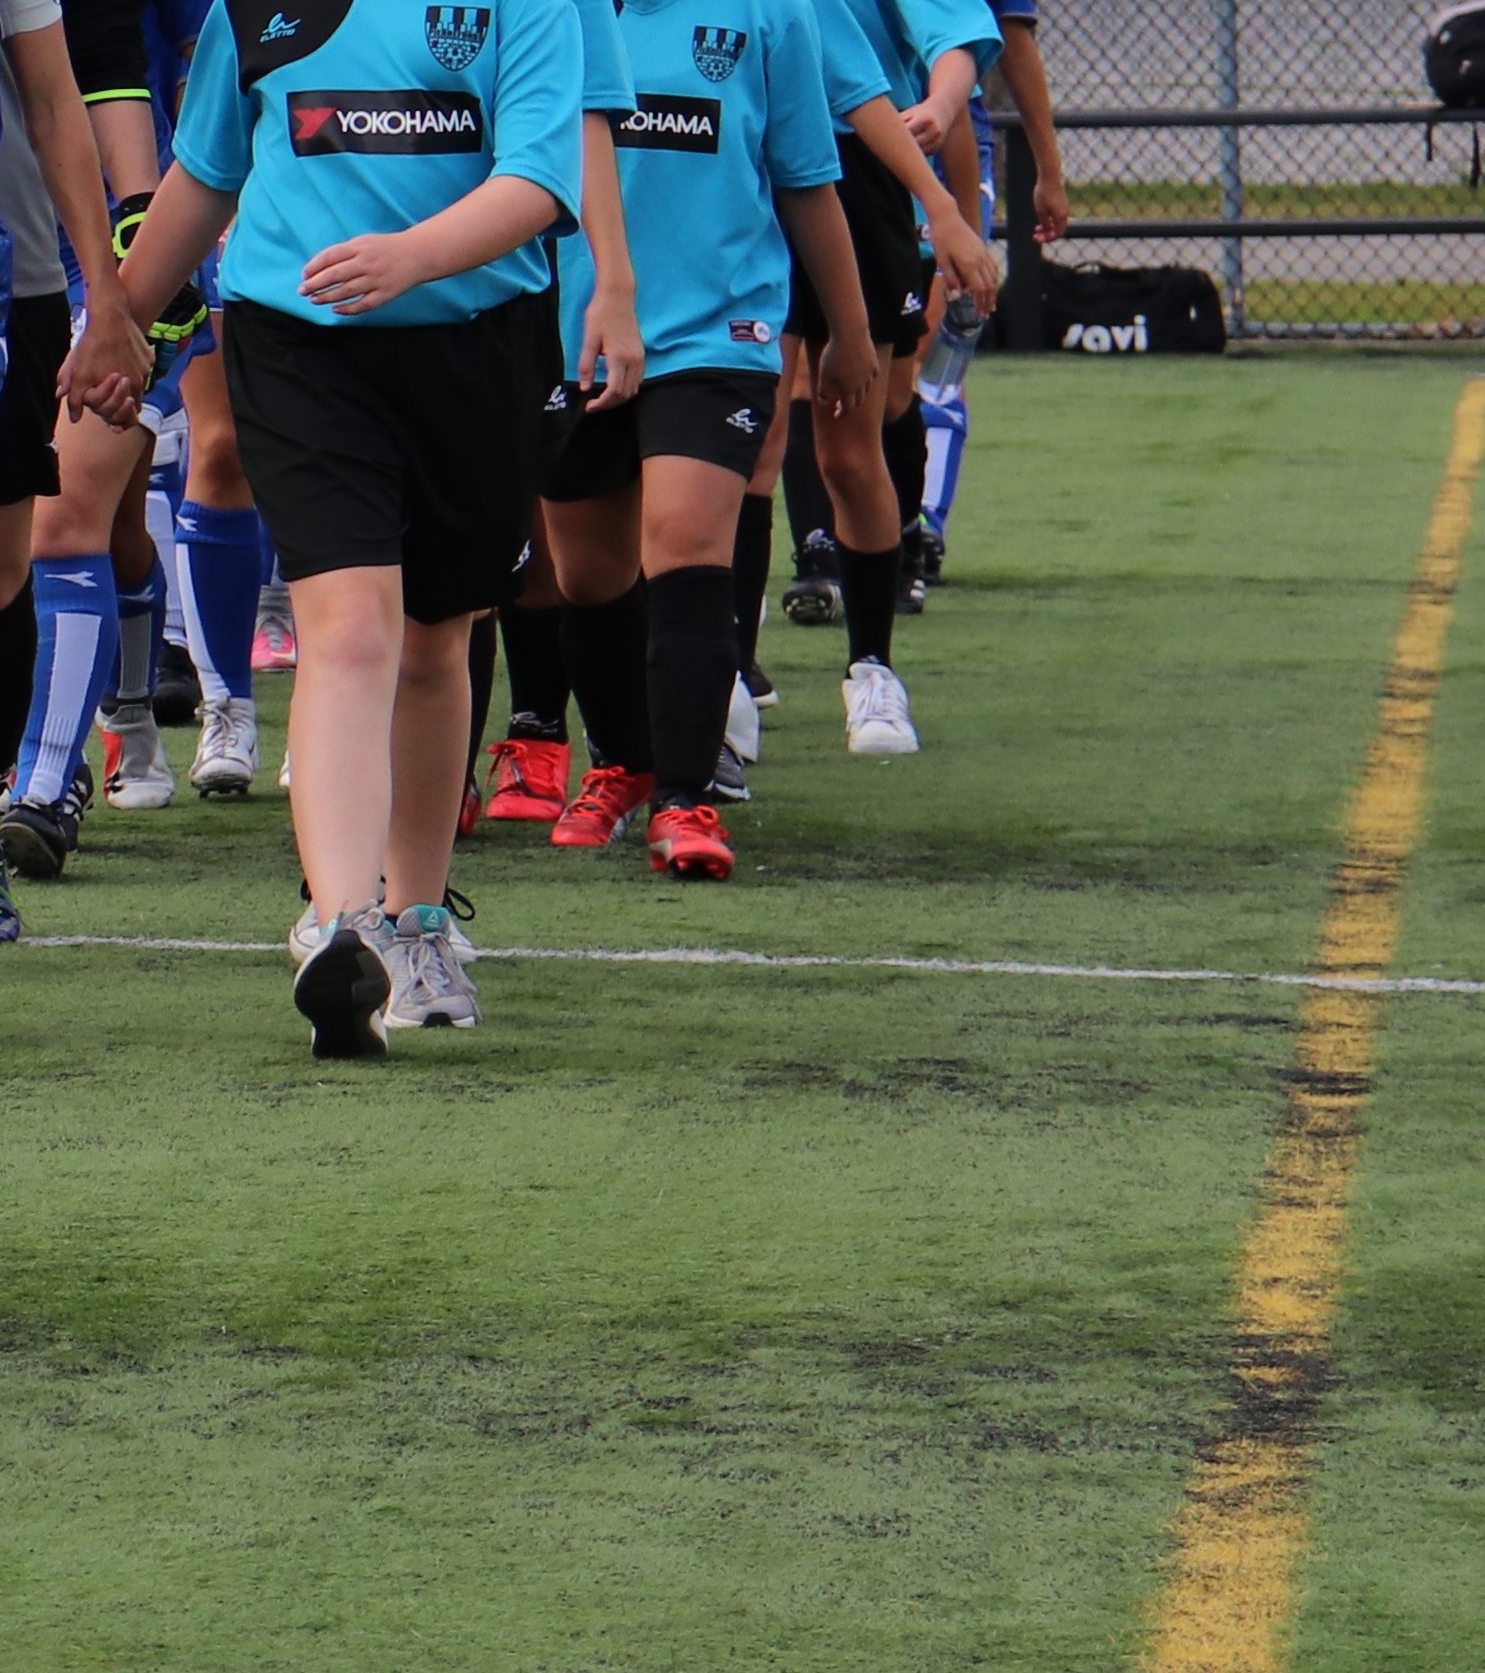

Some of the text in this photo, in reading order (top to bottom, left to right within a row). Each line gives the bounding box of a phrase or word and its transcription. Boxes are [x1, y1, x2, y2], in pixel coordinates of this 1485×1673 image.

[336, 110, 476, 135] YOKOHAMA
[620, 111, 713, 136] OHAMA
[1062, 314, 1148, 352] savi
